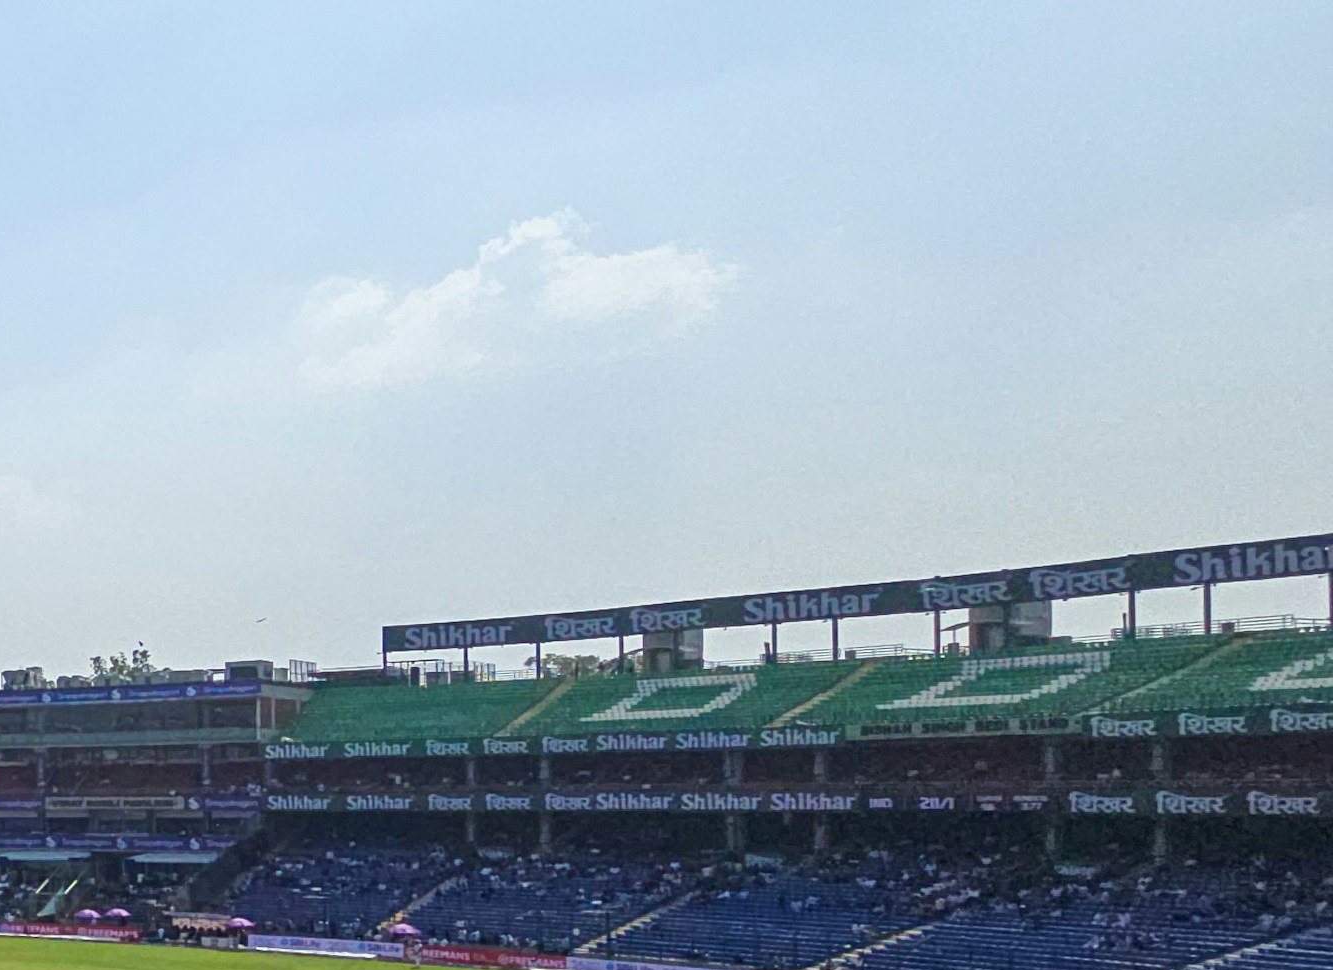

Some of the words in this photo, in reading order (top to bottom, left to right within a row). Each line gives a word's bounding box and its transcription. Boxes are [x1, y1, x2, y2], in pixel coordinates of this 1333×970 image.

[919, 578, 1010, 609] शिखर
[1029, 566, 1132, 600] शिखर
[743, 592, 880, 624] Shikhar
[544, 613, 617, 640] शिखर
[629, 607, 706, 634] शिखर
[404, 621, 513, 650] Shikhar
[1090, 715, 1158, 738] शिखर
[1177, 712, 1248, 736] शिखर
[264, 743, 331, 759] Shikhar
[343, 740, 412, 758] Shikhar
[425, 739, 470, 756] शिखर
[483, 737, 529, 755] शिखर
[542, 736, 590, 753] शिखर
[596, 732, 668, 751] Shikhar
[674, 730, 752, 750] Shikhar
[759, 728, 841, 748] Shikhar
[266, 794, 331, 811] Shikhar
[345, 793, 413, 811] Shikhar
[427, 793, 473, 811] शिखर
[485, 793, 532, 811] शिखर
[544, 792, 592, 811] शिखर
[595, 792, 672, 812] Shikhar
[680, 792, 763, 812] Shikhar
[769, 791, 857, 812] Shikhar
[1069, 791, 1136, 814] शिखर
[1155, 790, 1228, 814] शिखर
[1247, 790, 1321, 815] शिखर
[422, 948, 470, 961] REEMANS
